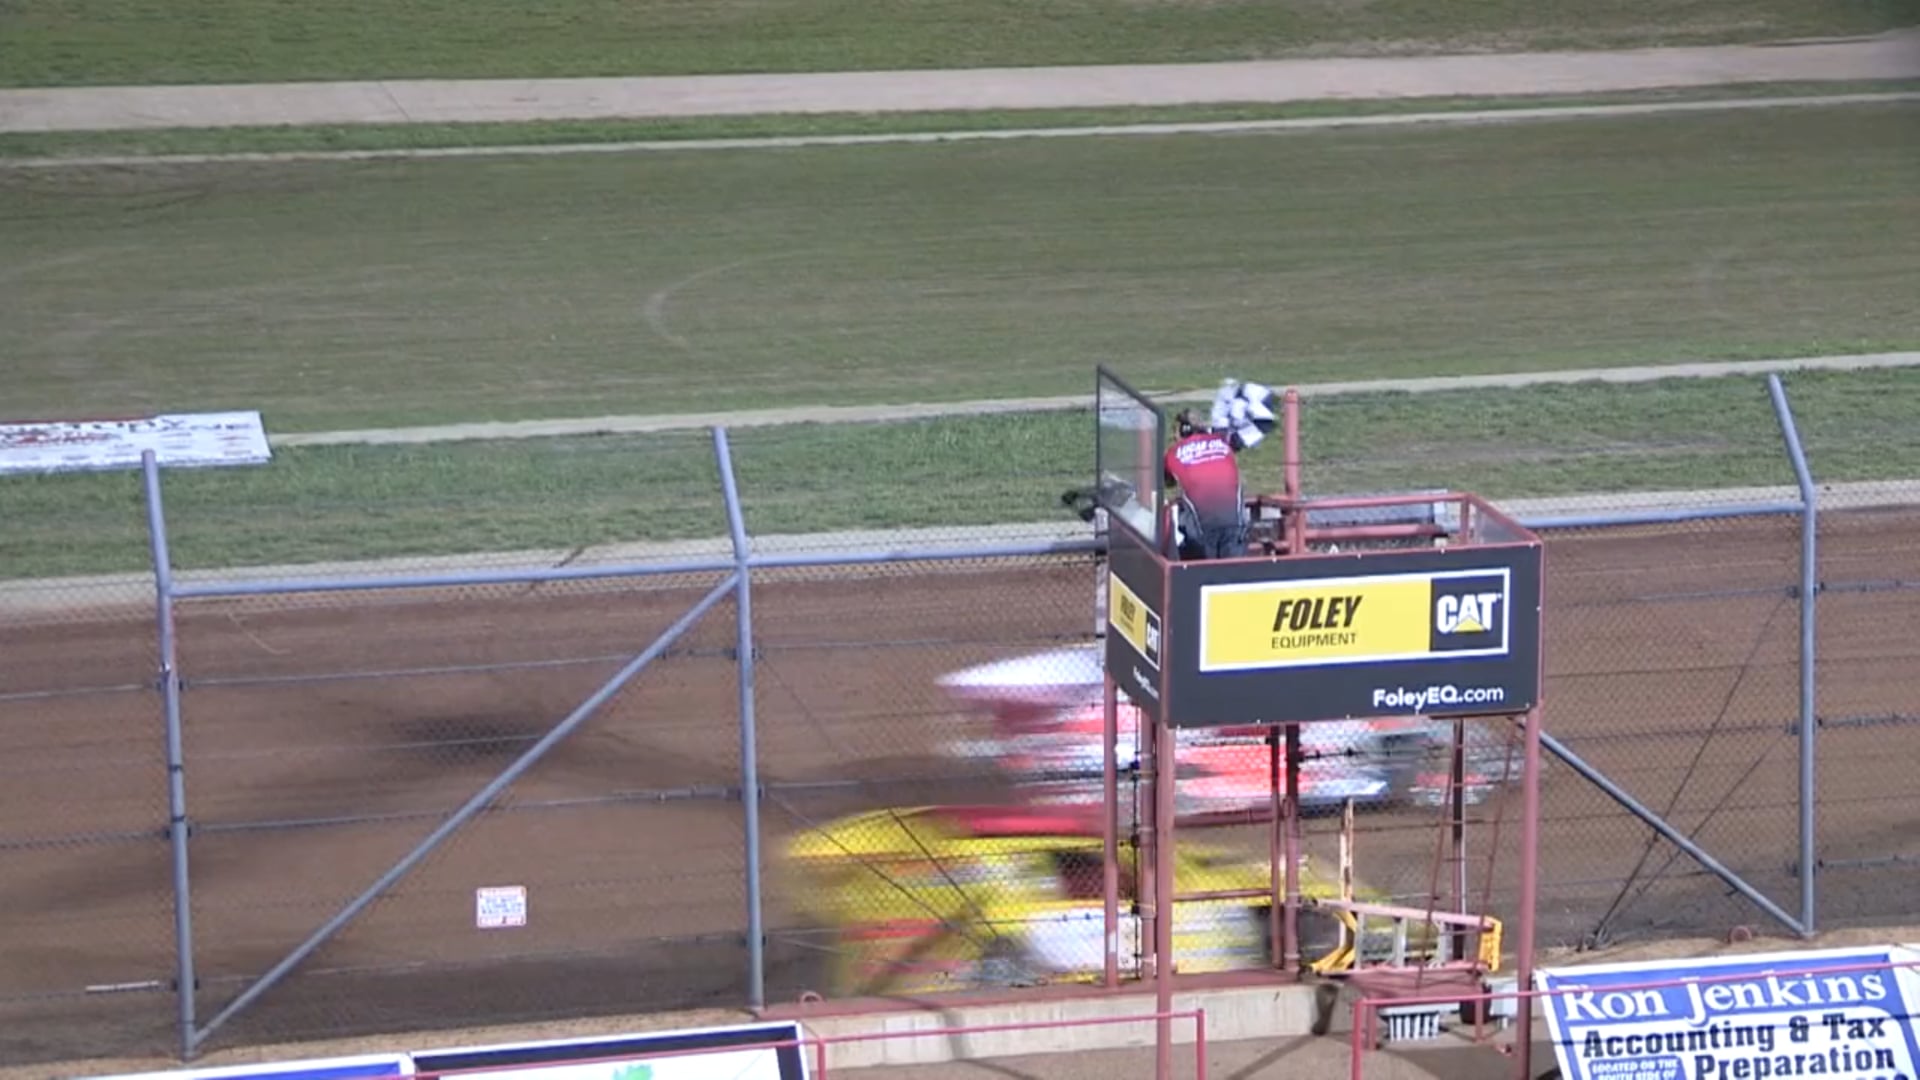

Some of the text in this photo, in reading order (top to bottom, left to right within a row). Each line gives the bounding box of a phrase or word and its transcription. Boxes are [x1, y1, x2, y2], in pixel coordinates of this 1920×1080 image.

[1272, 595, 1363, 632] FOLEY
[1436, 593, 1502, 634] CAT
[1271, 632, 1357, 649] EQUIPMENT
[1373, 684, 1504, 709] FoleyEQ.com
[1556, 969, 1887, 1026] Ron Jenkins
[1583, 1012, 1886, 1058] Accounting & Tax
[1592, 1058, 1678, 1074] LOCATED ON THE
[1694, 1044, 1896, 1080] Preparation
